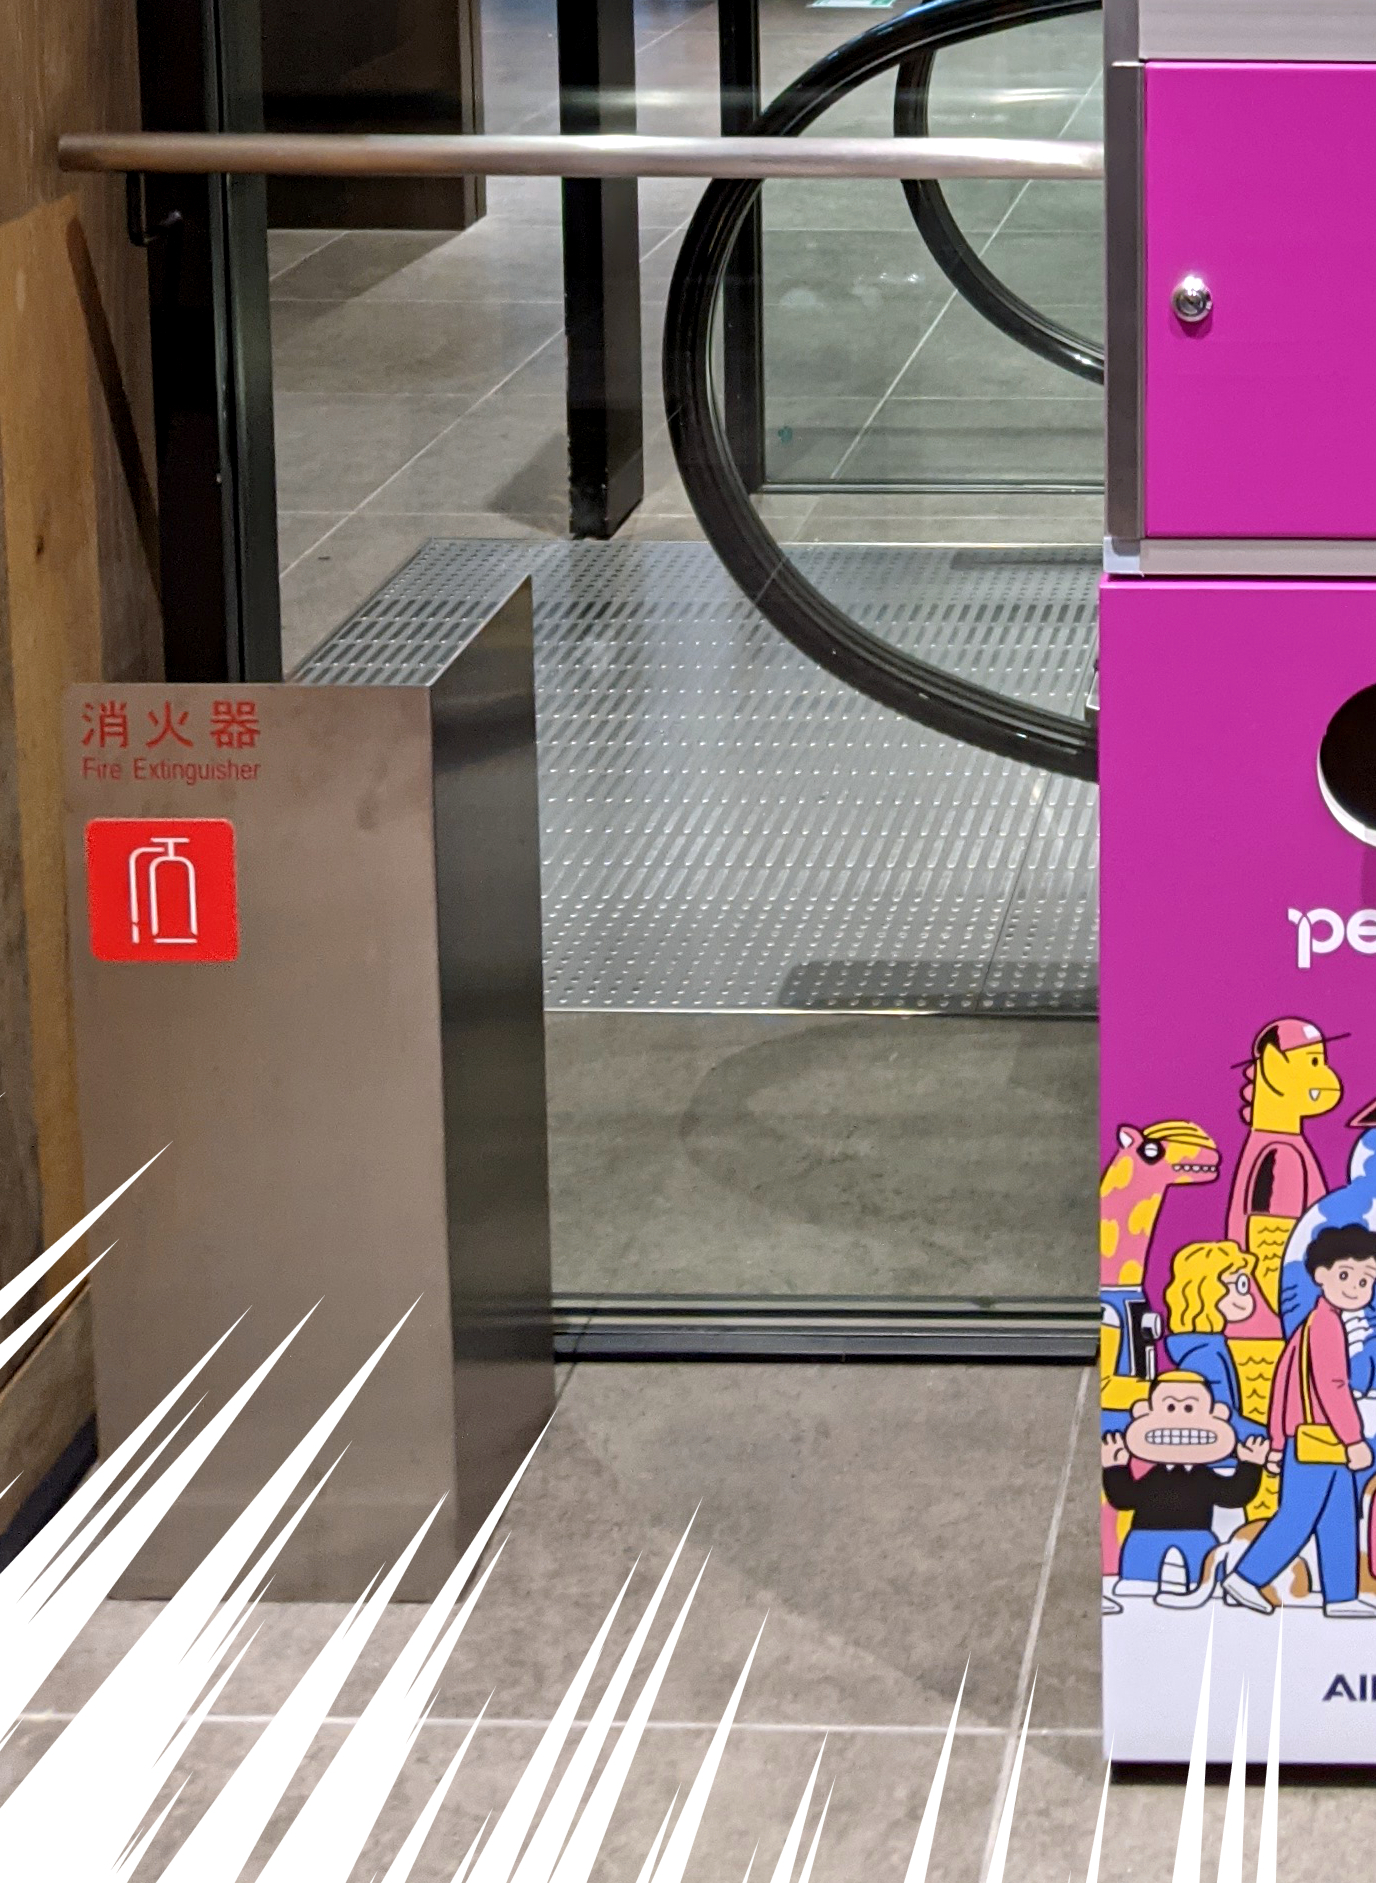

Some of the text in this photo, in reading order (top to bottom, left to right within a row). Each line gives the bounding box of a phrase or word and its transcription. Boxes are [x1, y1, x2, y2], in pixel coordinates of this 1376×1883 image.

[81, 699, 262, 750] 消火器
[81, 756, 262, 787] Fire Extinguisher
